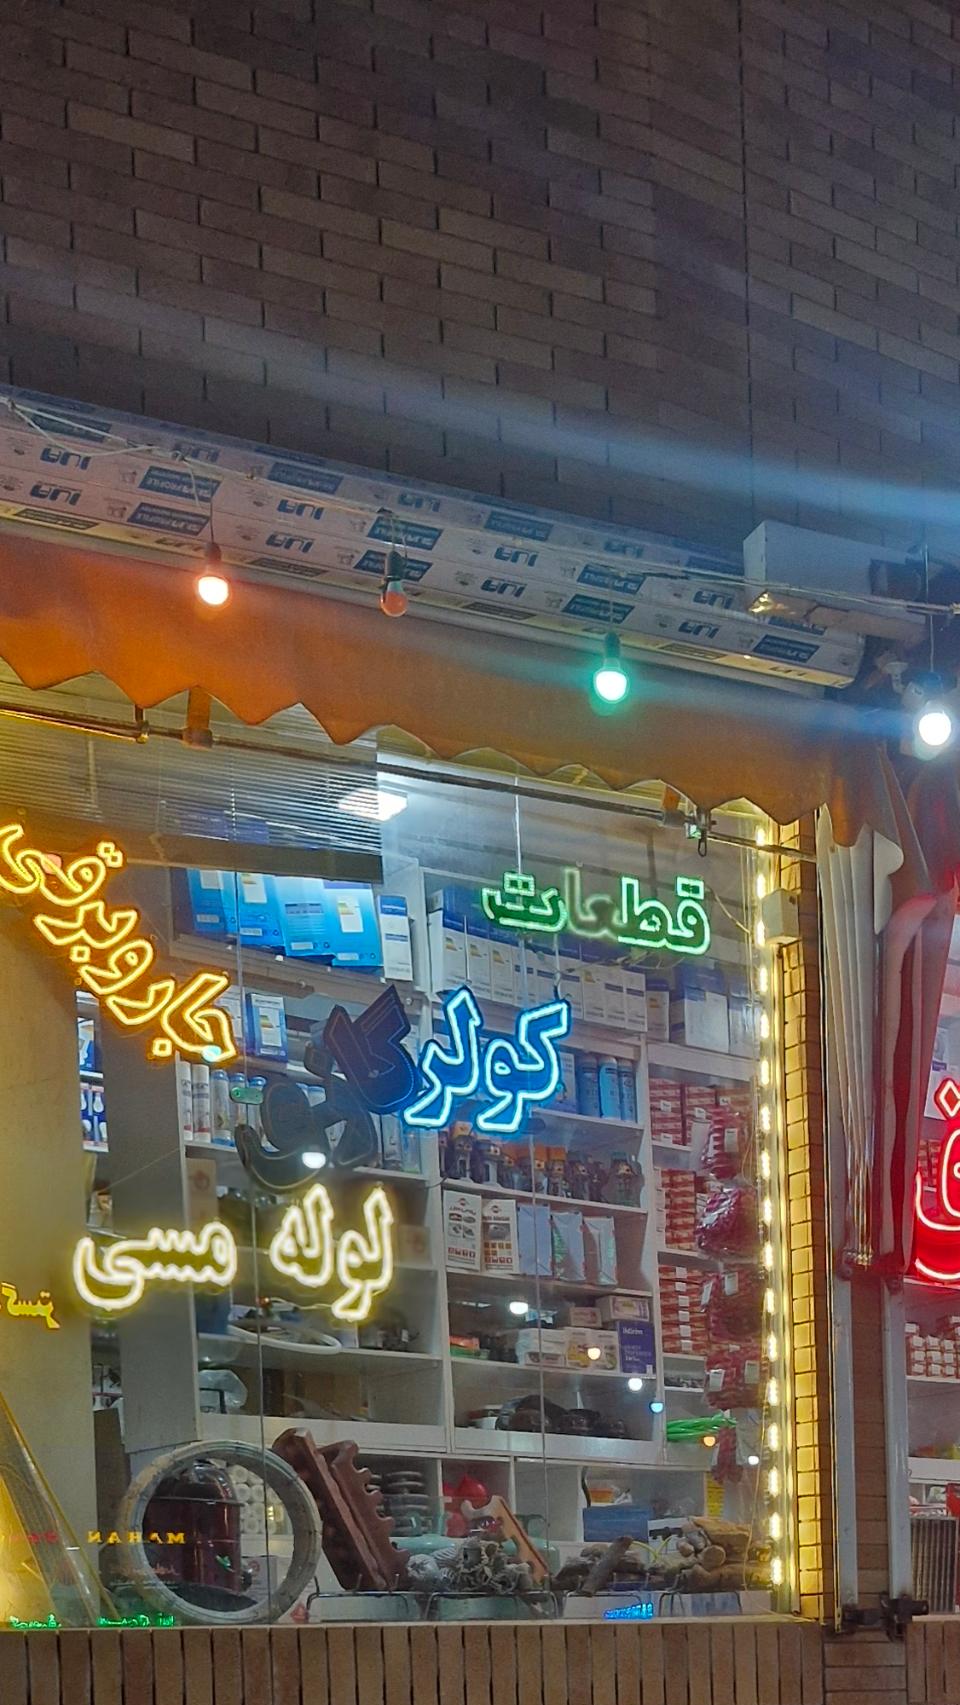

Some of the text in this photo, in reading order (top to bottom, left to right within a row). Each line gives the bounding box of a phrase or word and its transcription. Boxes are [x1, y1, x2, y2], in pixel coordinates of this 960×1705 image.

[0, 823, 237, 1063] جاروبرقی
[481, 867, 712, 956] قطعات
[402, 986, 570, 1135] کولر
[72, 1182, 394, 1322] لوله مسی
